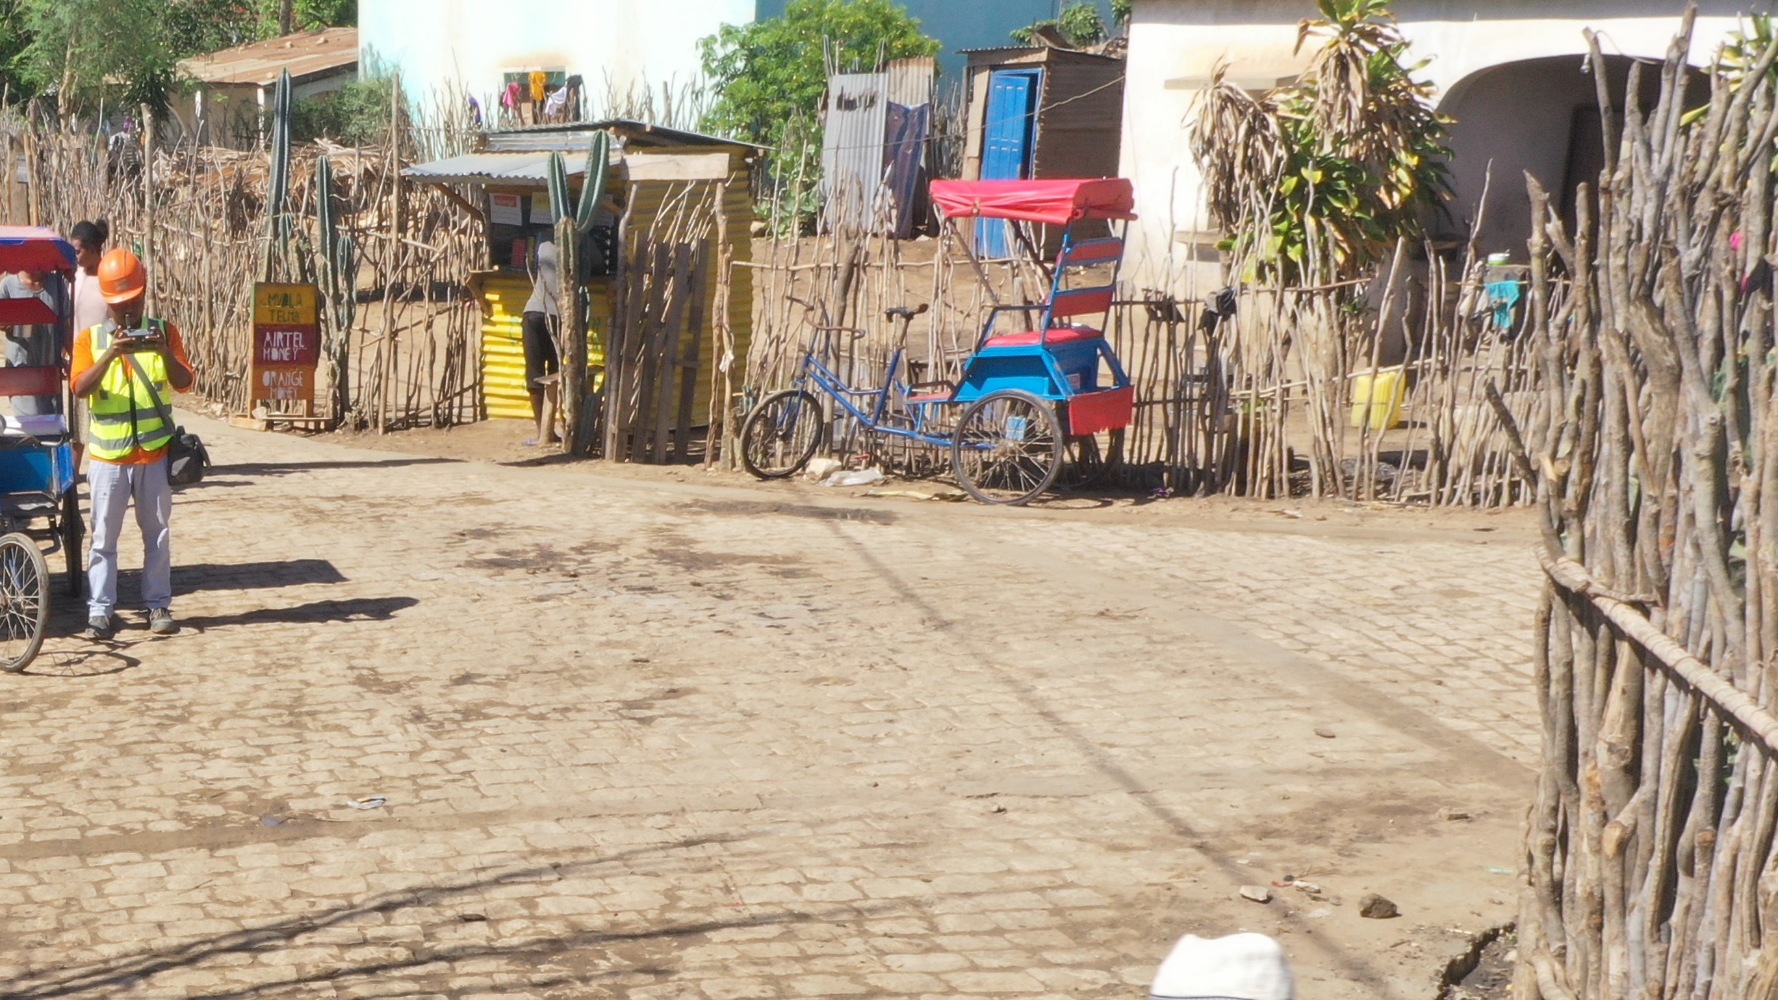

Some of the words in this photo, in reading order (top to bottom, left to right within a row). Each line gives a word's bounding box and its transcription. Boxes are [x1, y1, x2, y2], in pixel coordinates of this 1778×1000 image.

[269, 310, 300, 323] TELMA
[263, 331, 305, 348] AIRTEL
[262, 347, 299, 361] MONEY
[262, 370, 304, 387] ORANGE
[269, 387, 298, 400] MONEY
